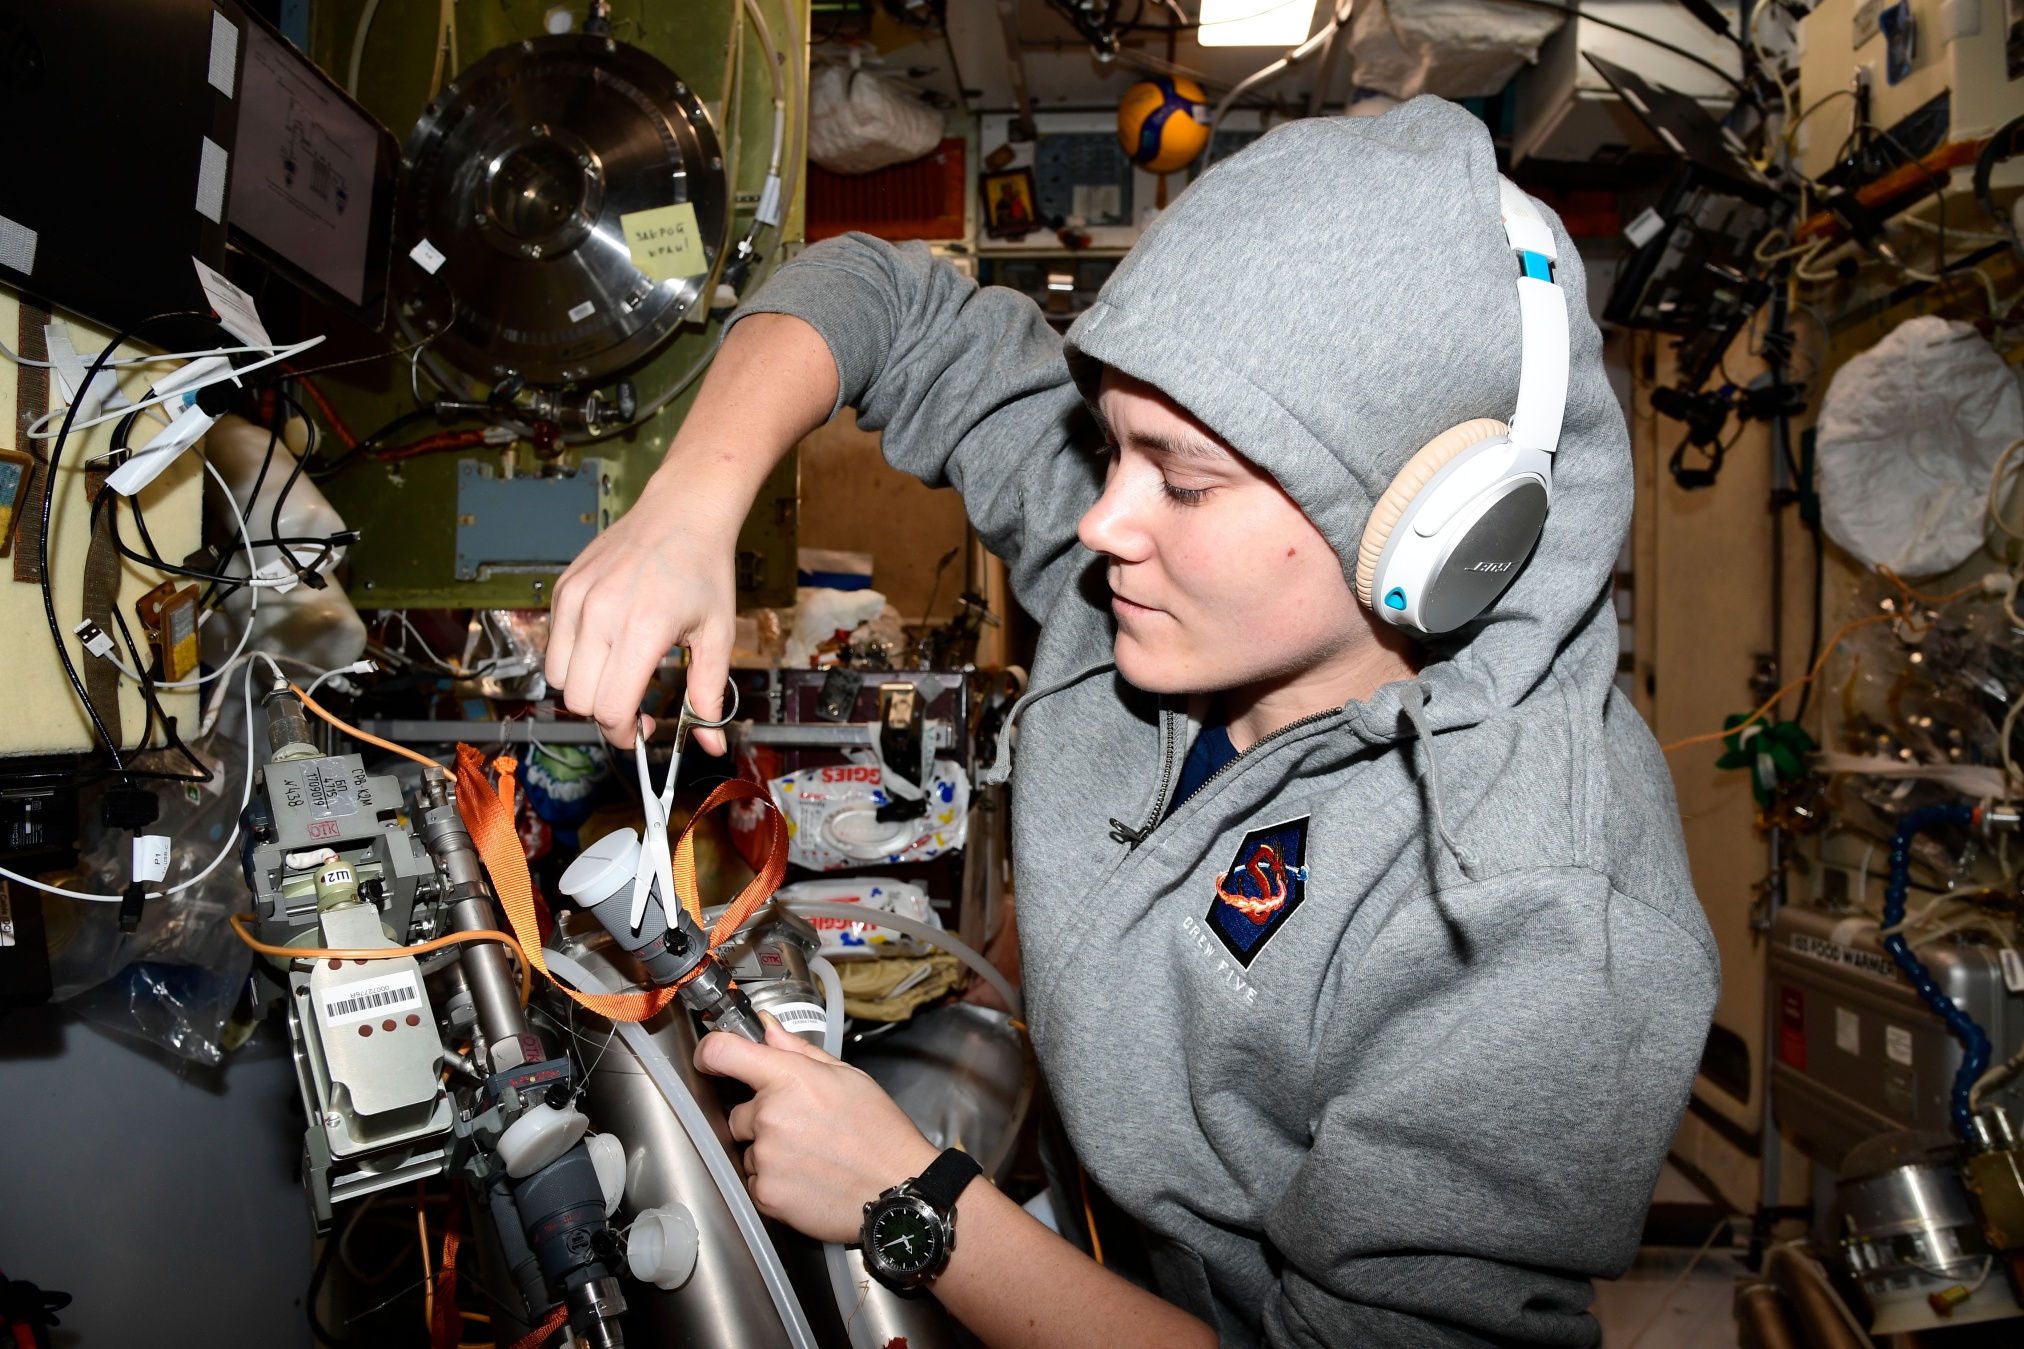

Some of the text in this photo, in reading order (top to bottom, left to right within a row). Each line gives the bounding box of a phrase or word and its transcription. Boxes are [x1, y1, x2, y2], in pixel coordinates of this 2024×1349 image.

[822, 767, 882, 785] GGIES
[306, 773, 325, 806] 1709019
[327, 870, 350, 883] Ш2
[1183, 916, 1258, 1003] CREW FIVE
[1811, 940, 1840, 961] FOOD
